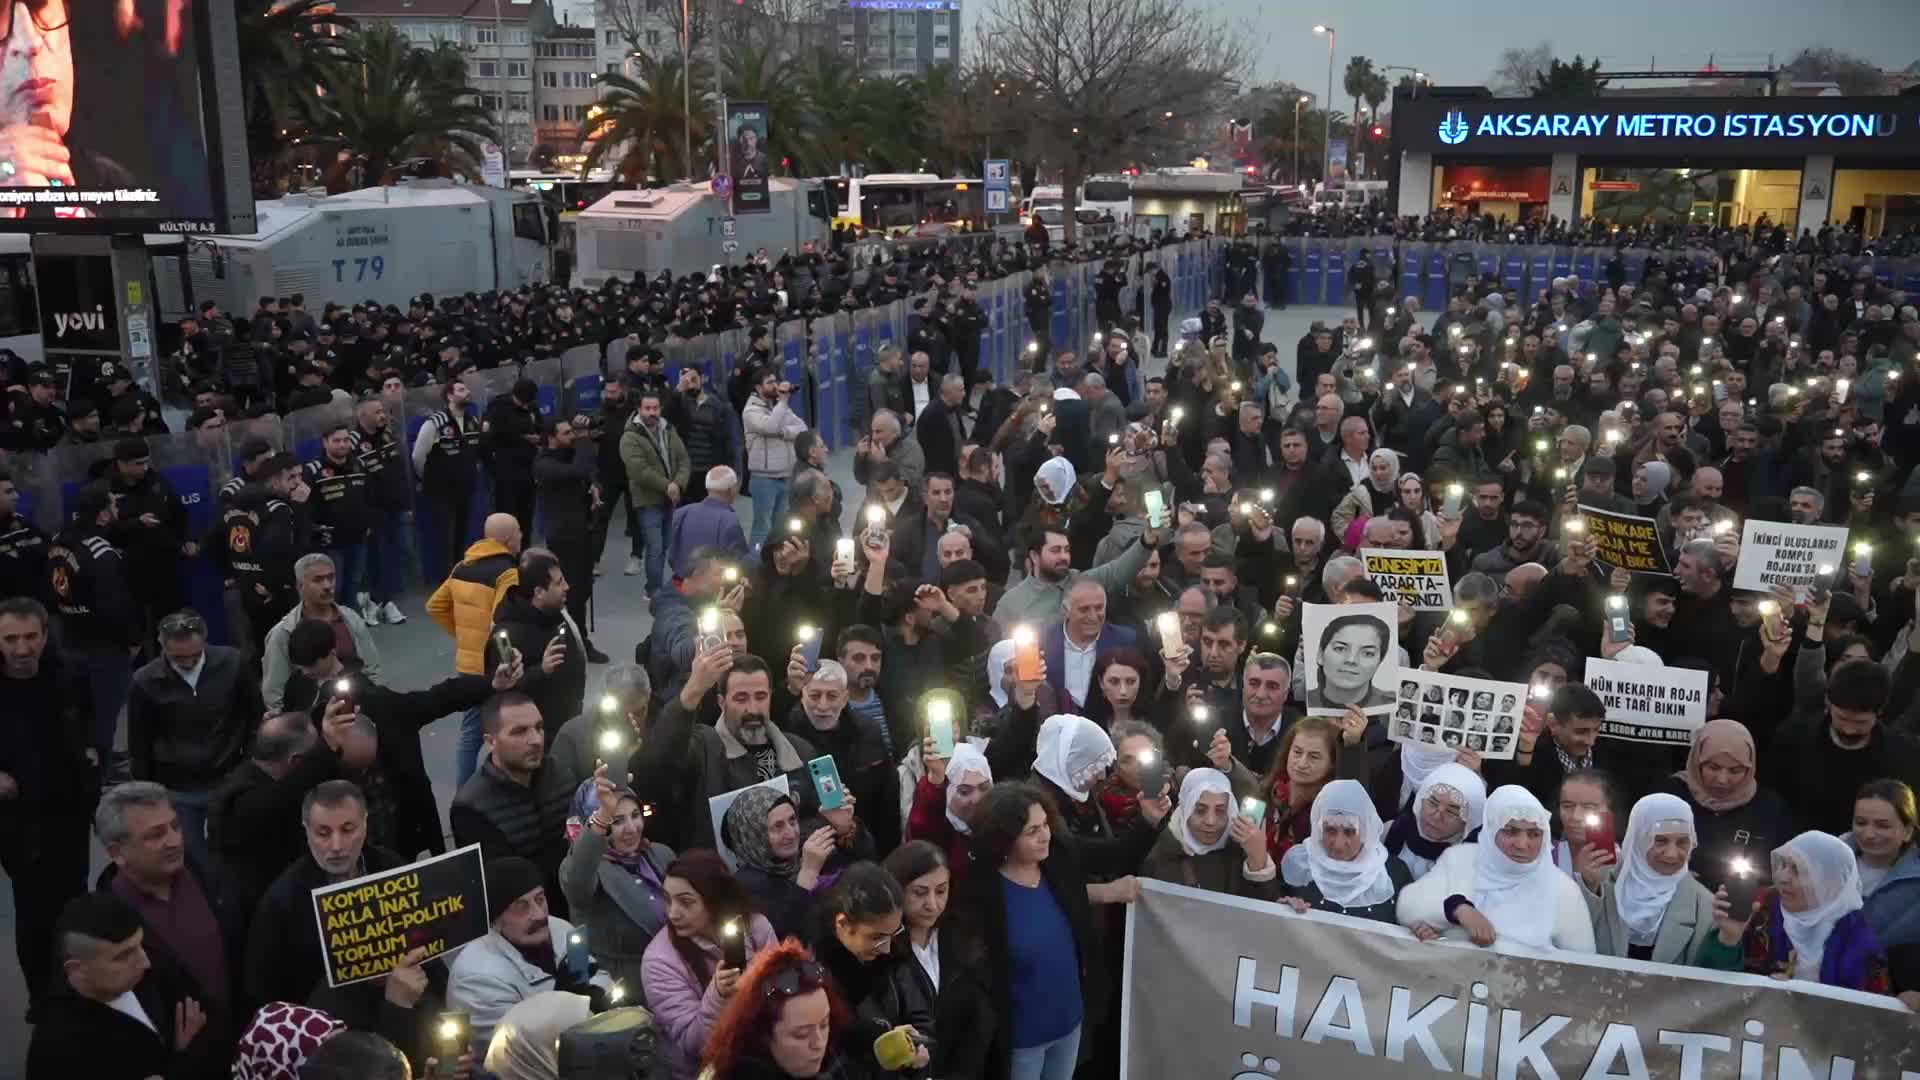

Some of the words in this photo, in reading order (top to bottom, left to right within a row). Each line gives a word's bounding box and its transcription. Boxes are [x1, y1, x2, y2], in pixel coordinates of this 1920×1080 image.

[1476, 114, 1609, 136] AKSARAY
[1616, 114, 1716, 136] METRO
[66, 192, 79, 202] ve
[80, 192, 114, 204] meyve
[159, 221, 197, 232] KÜLTÜR
[332, 259, 345, 282] T
[354, 255, 384, 282] 79
[54, 304, 105, 338] yovi
[1784, 536, 1838, 549] ULUSLARASI
[1775, 549, 1814, 561] KOMPLO
[1617, 681, 1666, 699] NEKARIN
[1670, 687, 1701, 703] ROJA
[1603, 695, 1621, 709] ME
[1654, 701, 1686, 717] BIKIN
[321, 873, 419, 913] KOMPLOCU
[327, 906, 374, 930] AKLA
[379, 891, 421, 917] İNAT
[333, 934, 407, 964] TOPLUM
